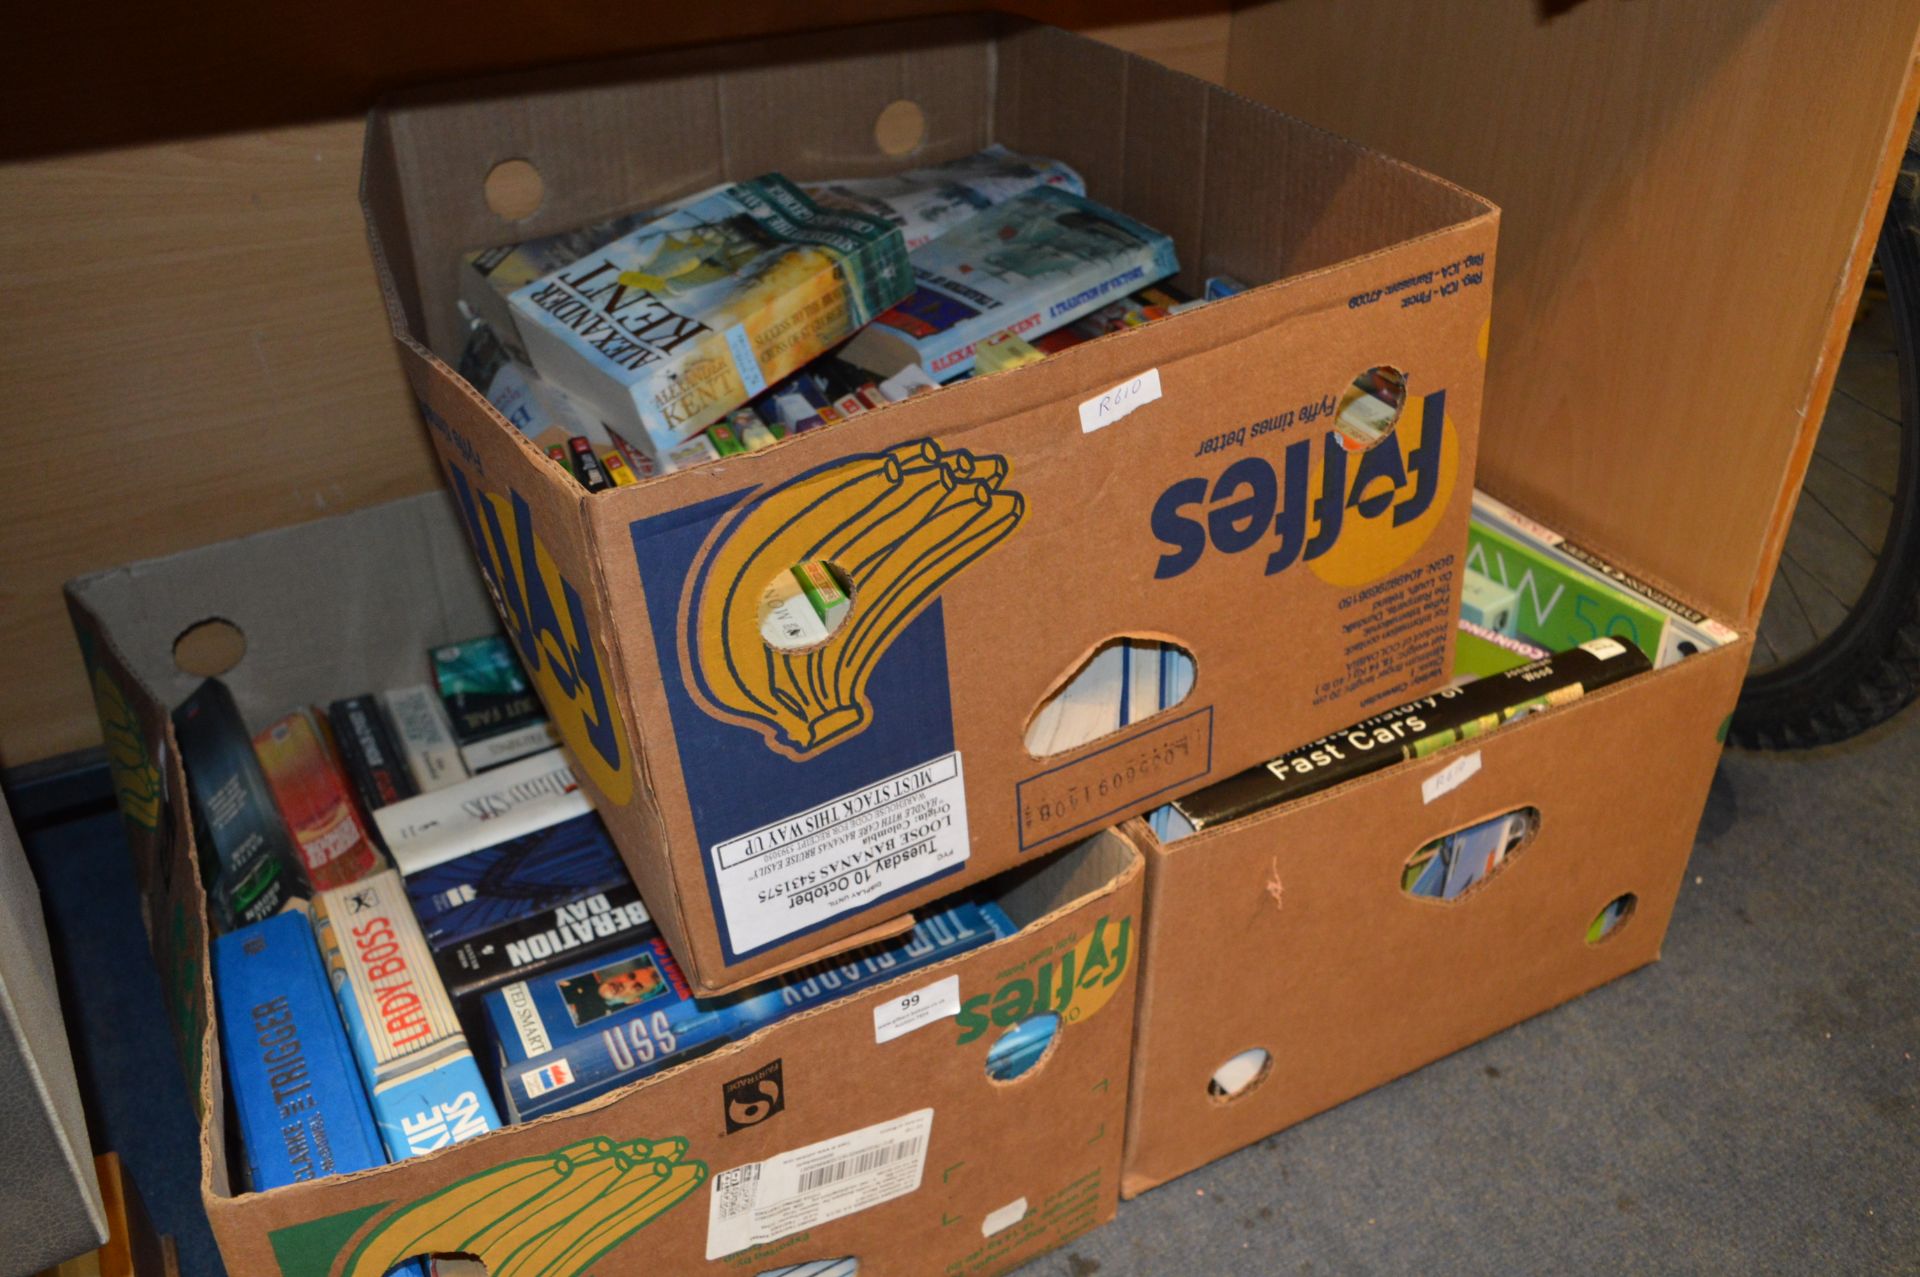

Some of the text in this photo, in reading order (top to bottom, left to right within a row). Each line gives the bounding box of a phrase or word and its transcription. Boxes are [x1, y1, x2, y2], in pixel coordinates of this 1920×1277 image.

[563, 260, 713, 355] KENT
[1056, 288, 1098, 317] TRADITION
[1099, 281, 1110, 297] OF
[1109, 265, 1144, 291] VICTORY
[531, 284, 661, 370] ALEXANDER
[654, 357, 728, 409] ALEXANDER
[661, 372, 737, 431] KENT
[1195, 395, 1336, 457] Fyffe times better
[1151, 373, 1446, 580] fyffes
[1266, 742, 1345, 781] Fast
[1348, 714, 1427, 750] Cars
[742, 767, 932, 856] MUST STACK THIS WAY UP
[831, 822, 848, 835] FOR
[849, 812, 873, 828] CODE
[857, 820, 879, 837] CARE
[861, 802, 950, 846] Origin: Colombia
[873, 791, 925, 819] WAREHOUSE
[881, 811, 902, 827] WITH
[756, 813, 951, 904] LOOSE BANANAS 5431575
[784, 846, 816, 866] BRUISE
[796, 829, 831, 849] RECEIPT
[816, 831, 855, 853] BANANAS
[787, 838, 936, 913] Tuesday 10 October
[827, 894, 849, 908] UNTIL
[505, 901, 650, 967] BERATION
[555, 892, 612, 928] DAY
[351, 915, 432, 1049] LADY BOSS
[901, 994, 920, 1011] 99
[508, 983, 526, 1009] TED
[520, 1009, 547, 1052] SMART
[253, 995, 313, 1105] TRIGGER
[726, 1062, 780, 1094] FAIRTRADE
[280, 1093, 318, 1121] THE
[282, 1119, 317, 1183] CLARKE
